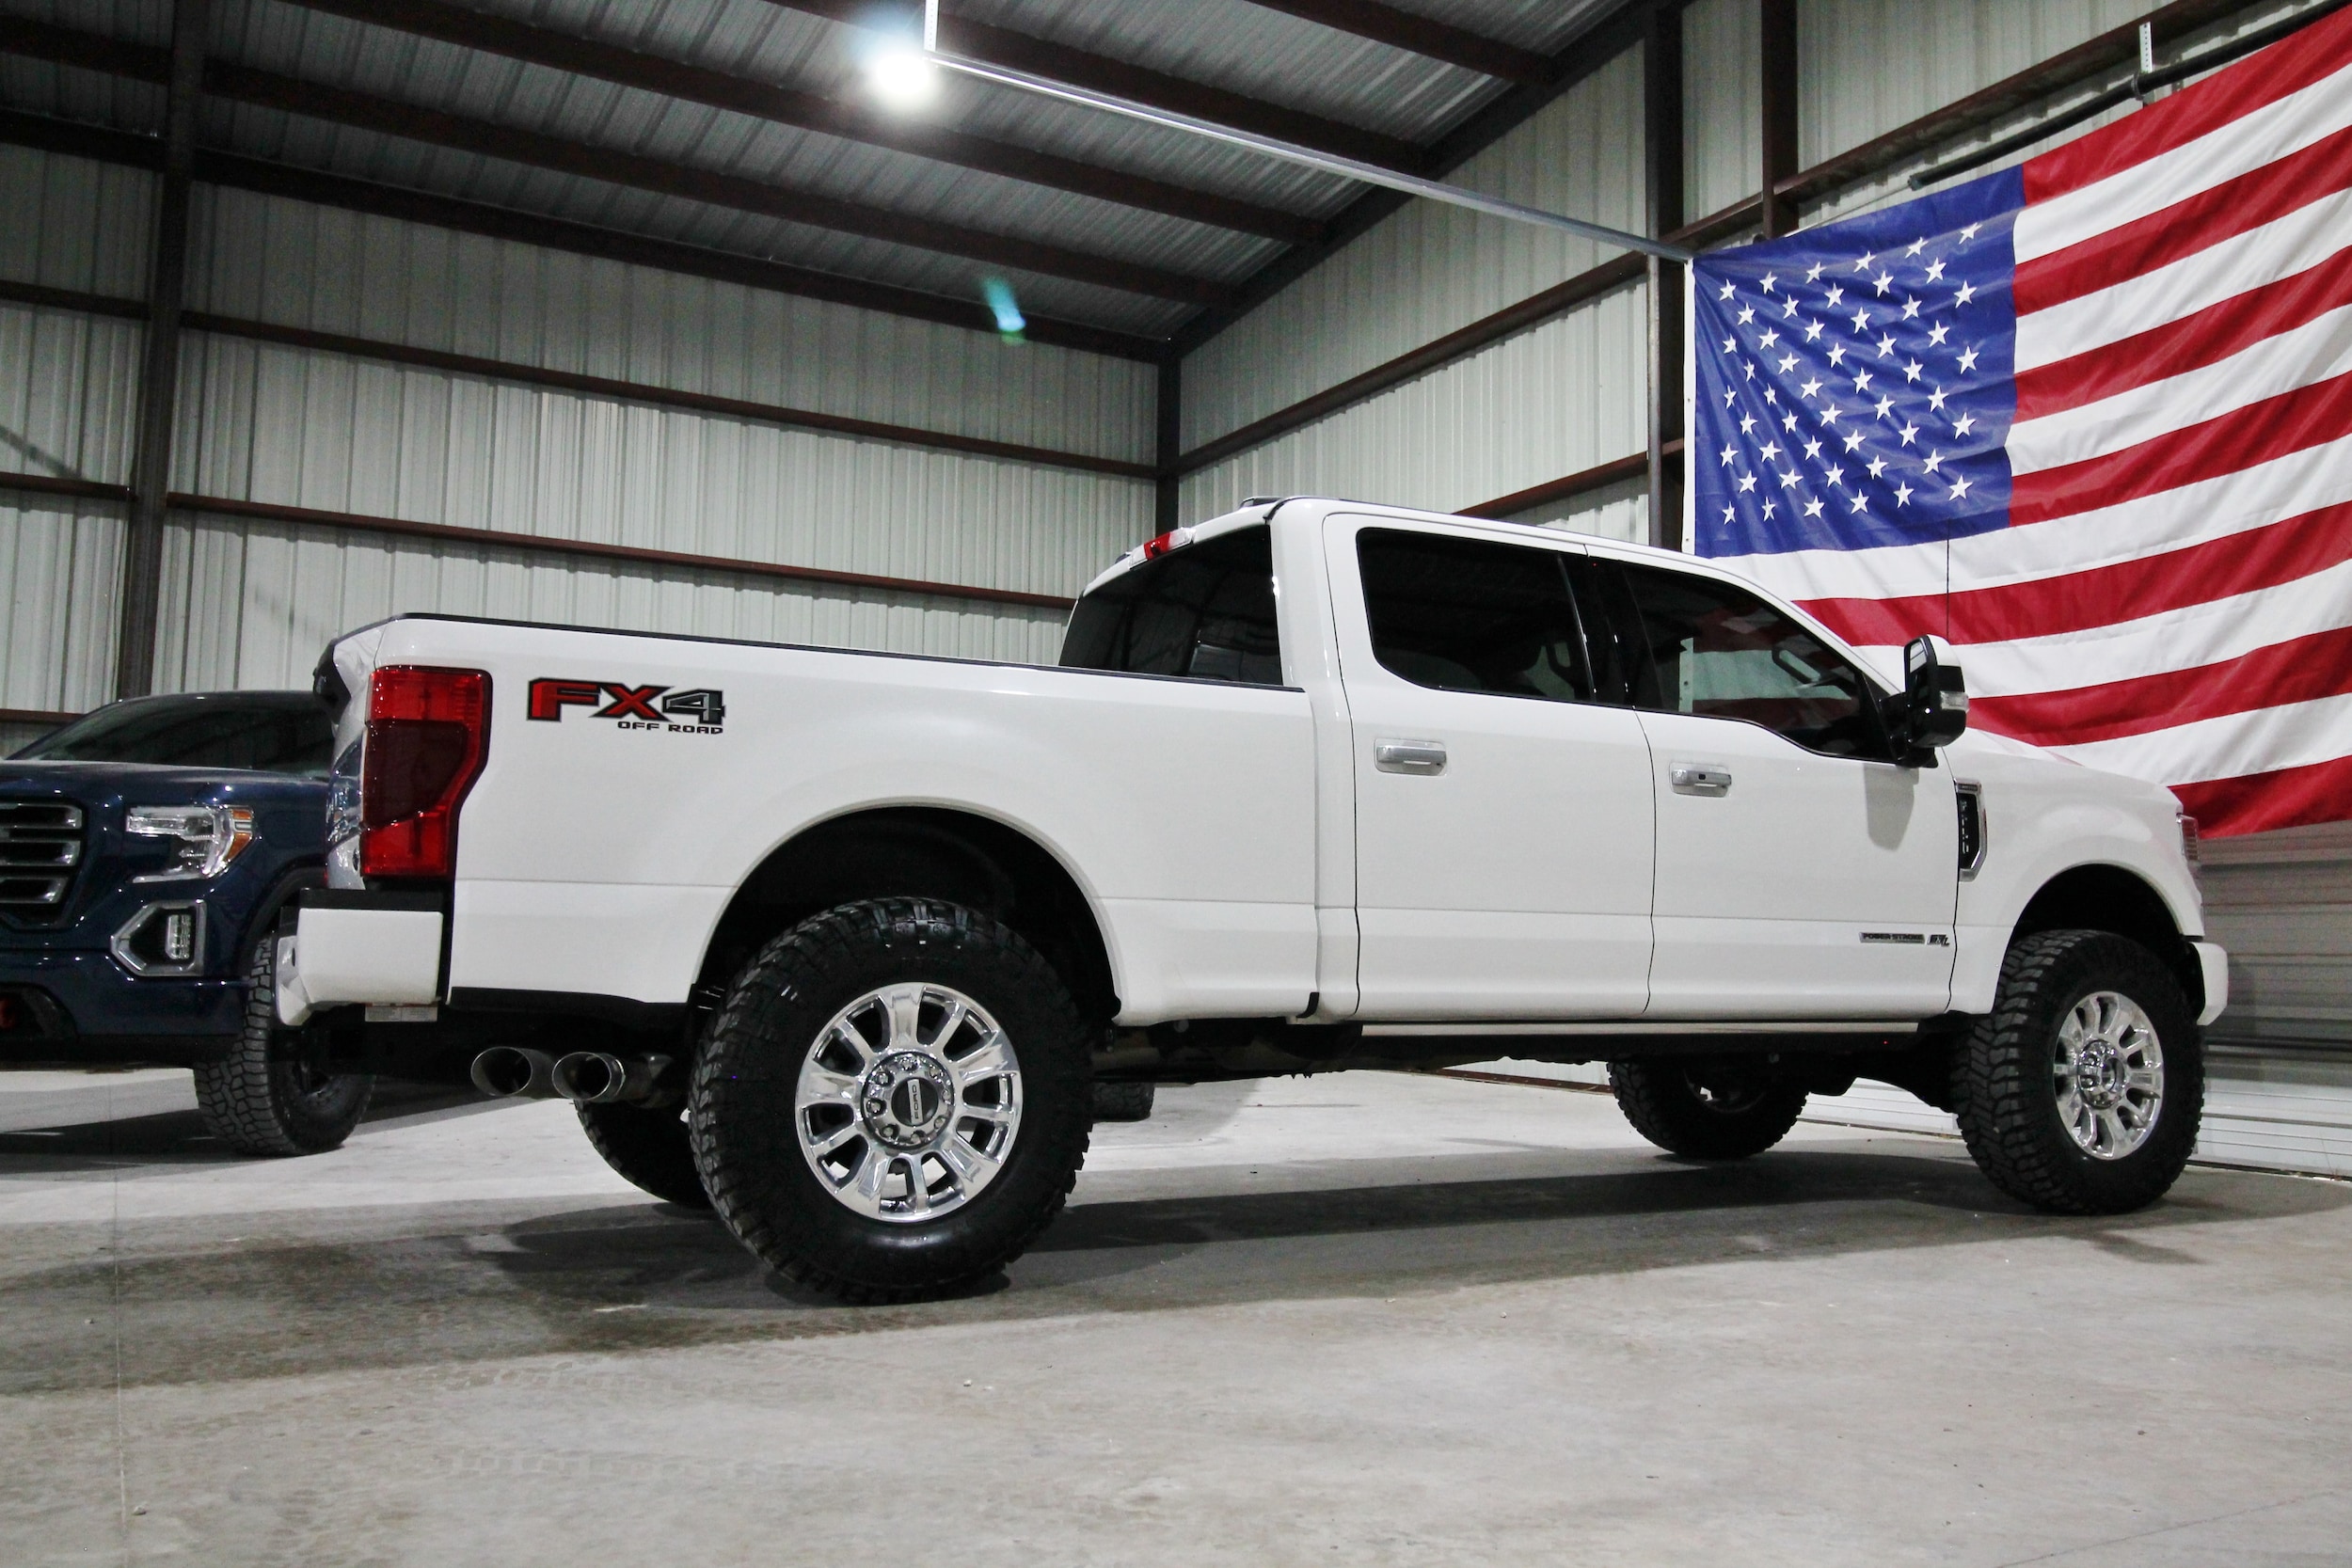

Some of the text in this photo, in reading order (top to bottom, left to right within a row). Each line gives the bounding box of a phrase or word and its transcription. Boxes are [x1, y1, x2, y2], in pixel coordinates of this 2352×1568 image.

[527, 677, 725, 725] FX4
[617, 721, 723, 735] OFF ROAD
